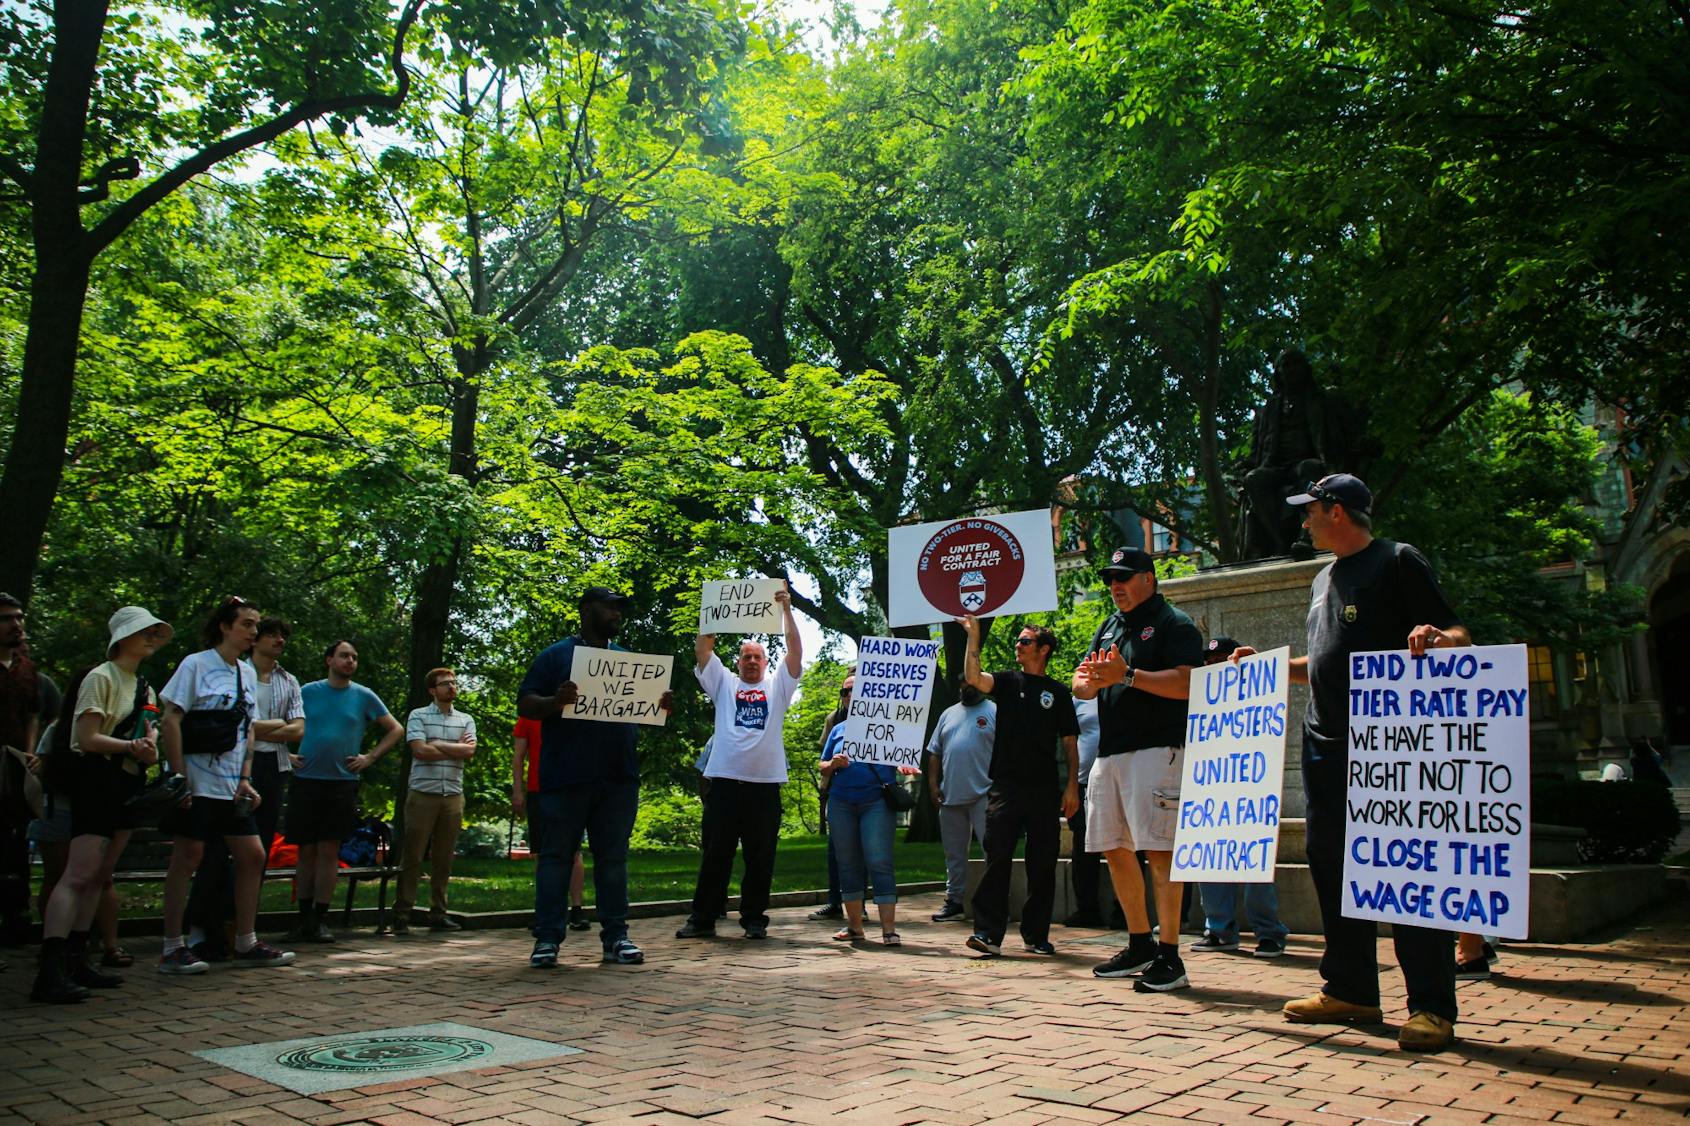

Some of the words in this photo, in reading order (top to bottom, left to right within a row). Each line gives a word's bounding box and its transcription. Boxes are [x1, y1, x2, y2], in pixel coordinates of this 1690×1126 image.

[920, 556, 929, 571] NO
[967, 521, 982, 529] NO
[983, 523, 1021, 560] GIVEBACKS
[940, 553, 962, 564] FOR
[964, 553, 972, 562] A
[974, 550, 1000, 560] FAIR
[949, 542, 990, 554] UNITED
[942, 557, 1001, 572] CONTRACT
[720, 584, 755, 602] END
[702, 601, 774, 625] TWO-TIER
[860, 639, 901, 656] HARD
[905, 643, 939, 660] WORK
[588, 658, 666, 680] UNITED
[861, 661, 928, 681] DESERVES
[1352, 653, 1406, 681] END
[1410, 653, 1494, 680] TWO-
[603, 681, 635, 696] WE
[861, 682, 923, 701] RESPECT
[1205, 656, 1277, 705] UPENN
[574, 694, 661, 718] BARGAIN
[741, 706, 764, 717] WAR
[850, 699, 891, 720] EQUAL
[896, 704, 924, 723] PAY
[1350, 688, 1402, 718] TIER
[1409, 687, 1468, 718] RATE
[1476, 688, 1527, 718] PAY
[865, 723, 895, 742] FOR
[1188, 702, 1286, 743] TEAMSTERS
[1350, 725, 1379, 752] WE
[1384, 723, 1435, 752] HAVE
[1440, 722, 1488, 752] THE
[841, 740, 880, 763] EQUAL
[883, 745, 921, 766] WORK
[1193, 751, 1266, 786] UNITED
[1348, 760, 1412, 792] RIGHT
[1419, 759, 1471, 795] NOT
[1475, 761, 1512, 795] TO
[1180, 797, 1214, 830] FOR
[1217, 800, 1231, 827] A
[1235, 794, 1279, 826] FAIR
[1347, 799, 1414, 828] WORK
[1418, 800, 1461, 833] FOR
[1464, 801, 1523, 836] LESS
[1174, 838, 1274, 872] CONTRACT
[1351, 835, 1438, 872] CLOSE
[1448, 841, 1512, 877] THE
[1350, 879, 1435, 919] WAGE
[1439, 886, 1510, 927] GAP
